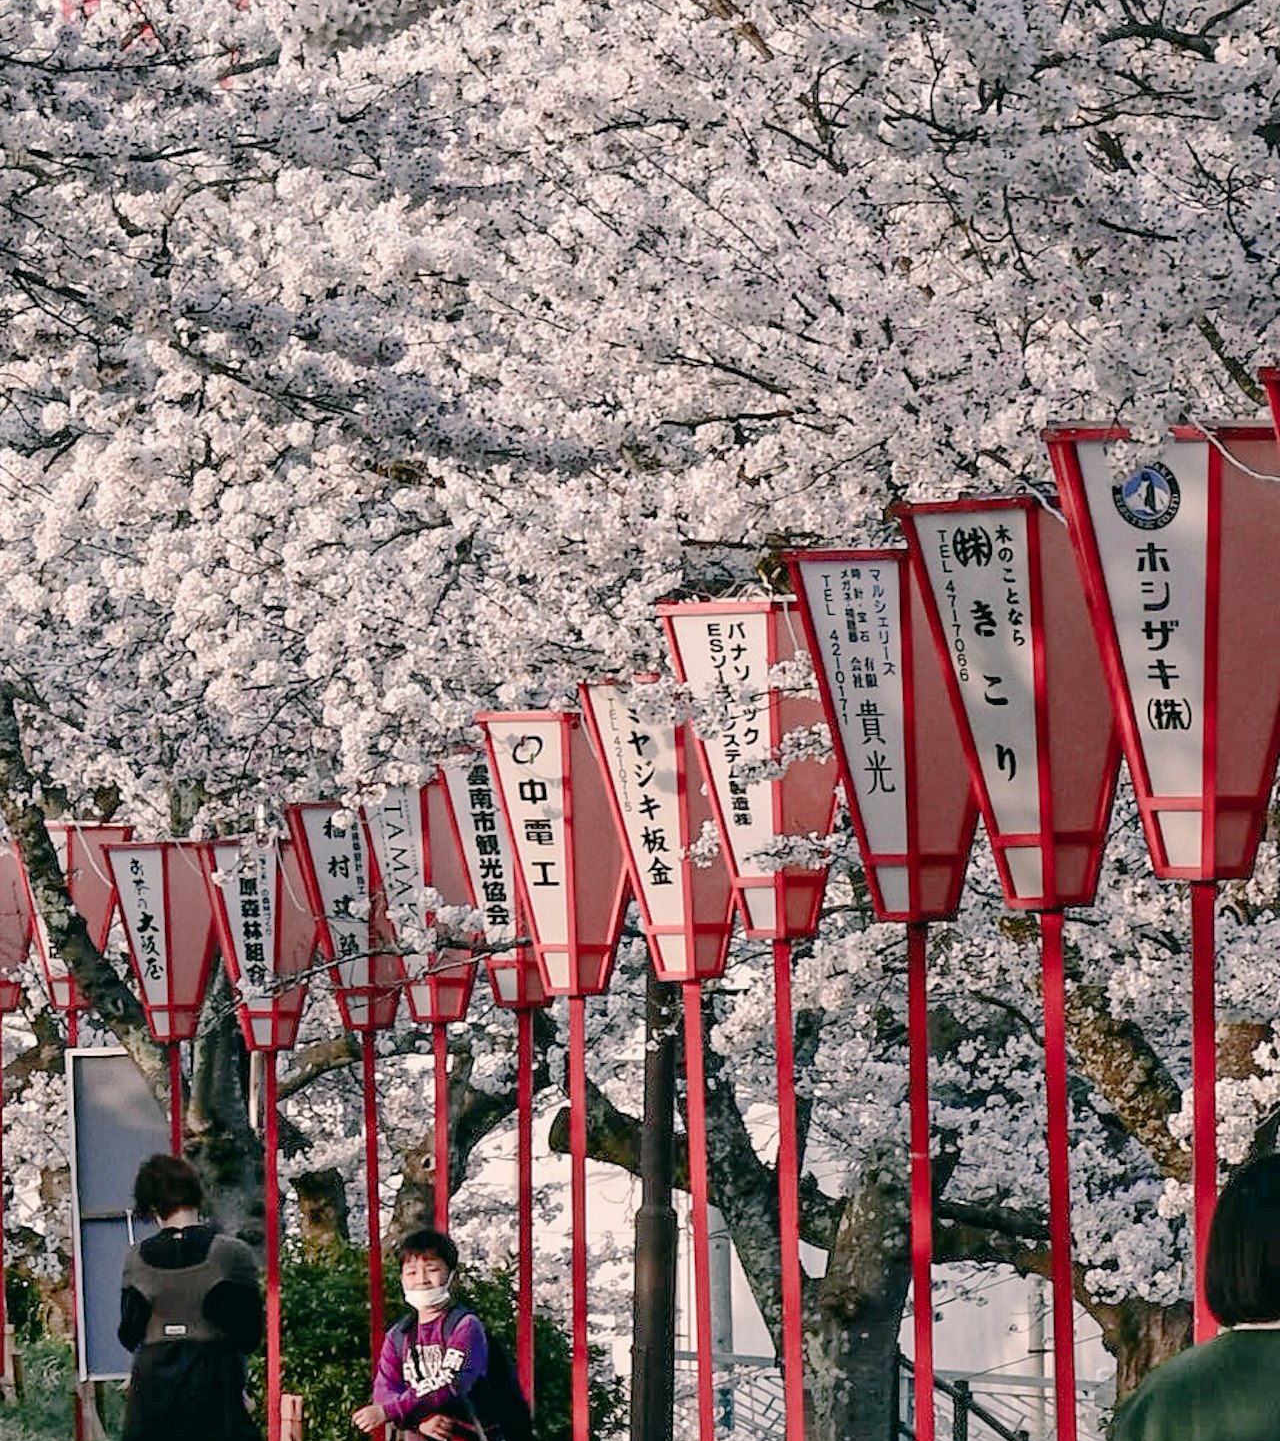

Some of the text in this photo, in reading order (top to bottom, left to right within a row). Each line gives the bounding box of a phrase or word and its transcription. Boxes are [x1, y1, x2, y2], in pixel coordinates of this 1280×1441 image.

[821, 575, 835, 616] TEL
[938, 529, 953, 573] TEL
[995, 524, 1025, 646] 木のことなら
[869, 569, 896, 676] マルシエリーズ
[1135, 542, 1192, 730] ホシザキ(株)
[608, 698, 619, 731] TEL
[728, 622, 758, 745] パナソック
[855, 699, 896, 795] 貴光
[467, 763, 509, 926] 雲南市観光協会
[518, 778, 560, 886] 中電工
[239, 863, 268, 986] 原森林組合
